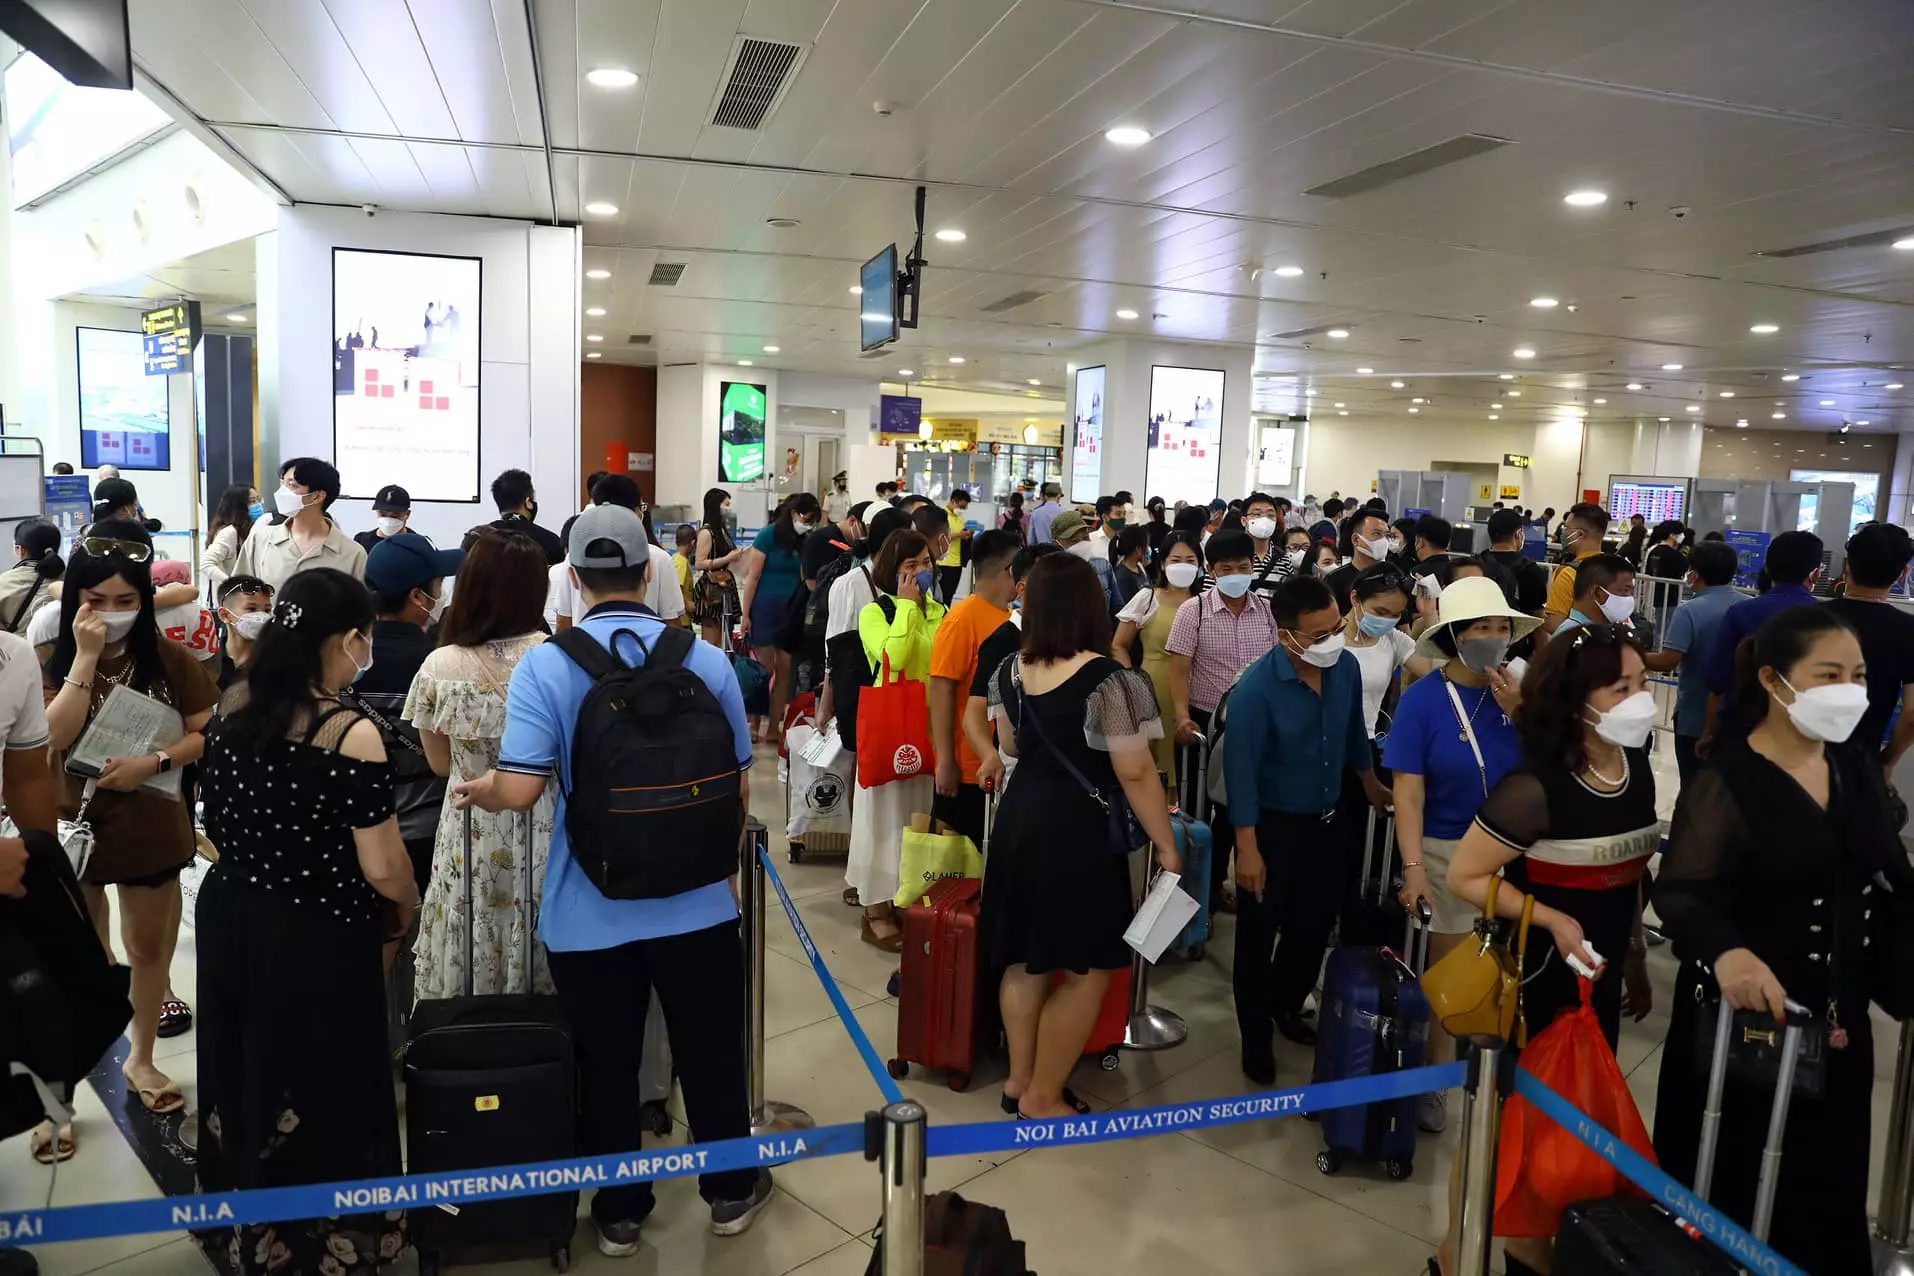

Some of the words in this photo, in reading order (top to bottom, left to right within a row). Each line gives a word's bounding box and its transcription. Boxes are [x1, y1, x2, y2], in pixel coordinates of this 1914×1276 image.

[358, 699, 393, 731] adidas
[1014, 1124, 1056, 1143] NOI
[1063, 1120, 1098, 1138] BAI
[1104, 1106, 1204, 1134] AVIATION
[1209, 1093, 1305, 1120] SECURITY
[758, 1137, 807, 1160] N.I.A
[334, 1184, 417, 1209] NOIBAI
[425, 1164, 608, 1199] INTERNATIONAL
[615, 1151, 708, 1179] AIRPORT
[172, 1201, 234, 1225] N.I.A
